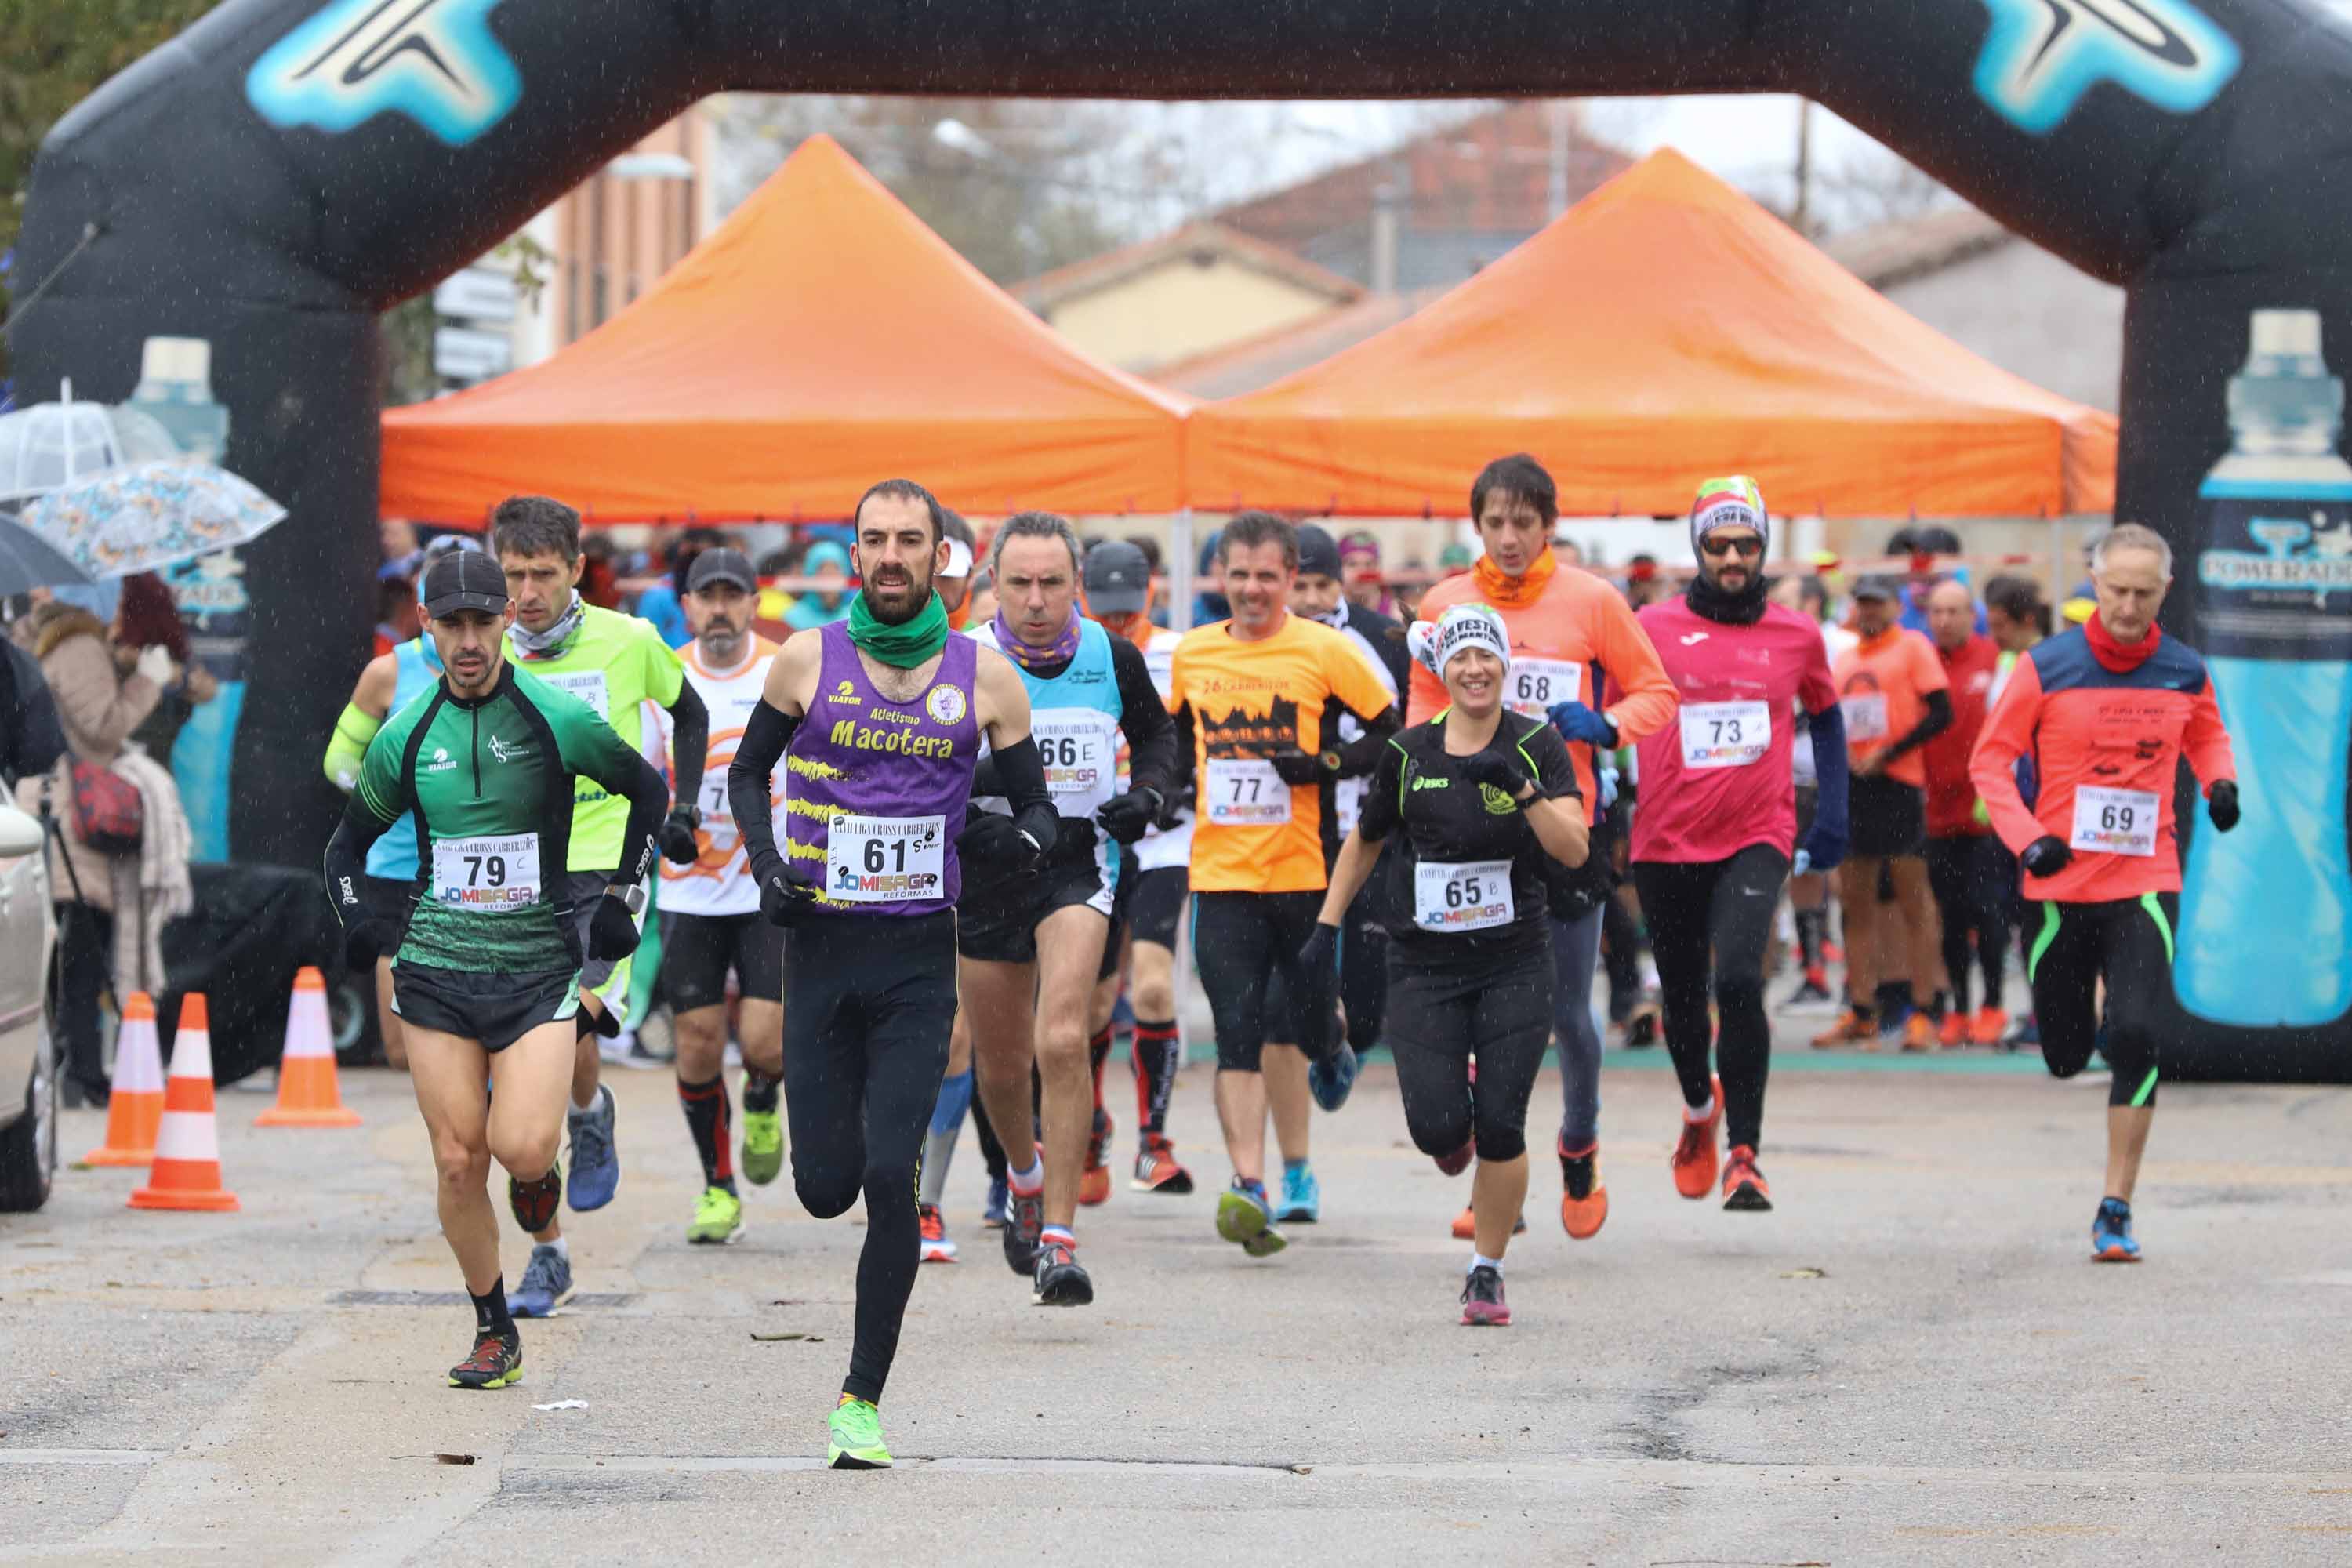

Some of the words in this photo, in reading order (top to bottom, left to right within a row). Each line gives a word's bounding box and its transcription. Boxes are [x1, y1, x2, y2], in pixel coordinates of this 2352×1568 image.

[1517, 673, 1550, 702] 68
[829, 695, 862, 706] VIATOR
[869, 707, 920, 726] Atletismo
[830, 719, 953, 759] Macotera
[1709, 719, 1742, 745] 73
[1039, 738, 1076, 767] 66
[1083, 742, 1096, 761] E
[428, 760, 458, 771] VIATOR
[1229, 778, 1261, 803] 77
[854, 822, 871, 835] LIGA
[873, 822, 897, 836] CROSS
[898, 821, 941, 836] CABRERIZOS
[2101, 804, 2135, 833] 69
[470, 841, 493, 854] CROSS
[493, 839, 535, 854] CABRERIZOS
[863, 837, 906, 873] 61
[463, 855, 506, 887] 79
[833, 873, 936, 892] JOMISAGA
[439, 886, 533, 904] JOMISAGA
[884, 889, 934, 899] REFORMAS
[1445, 877, 1482, 908] 65
[1424, 902, 1507, 925] JOMISAGA
